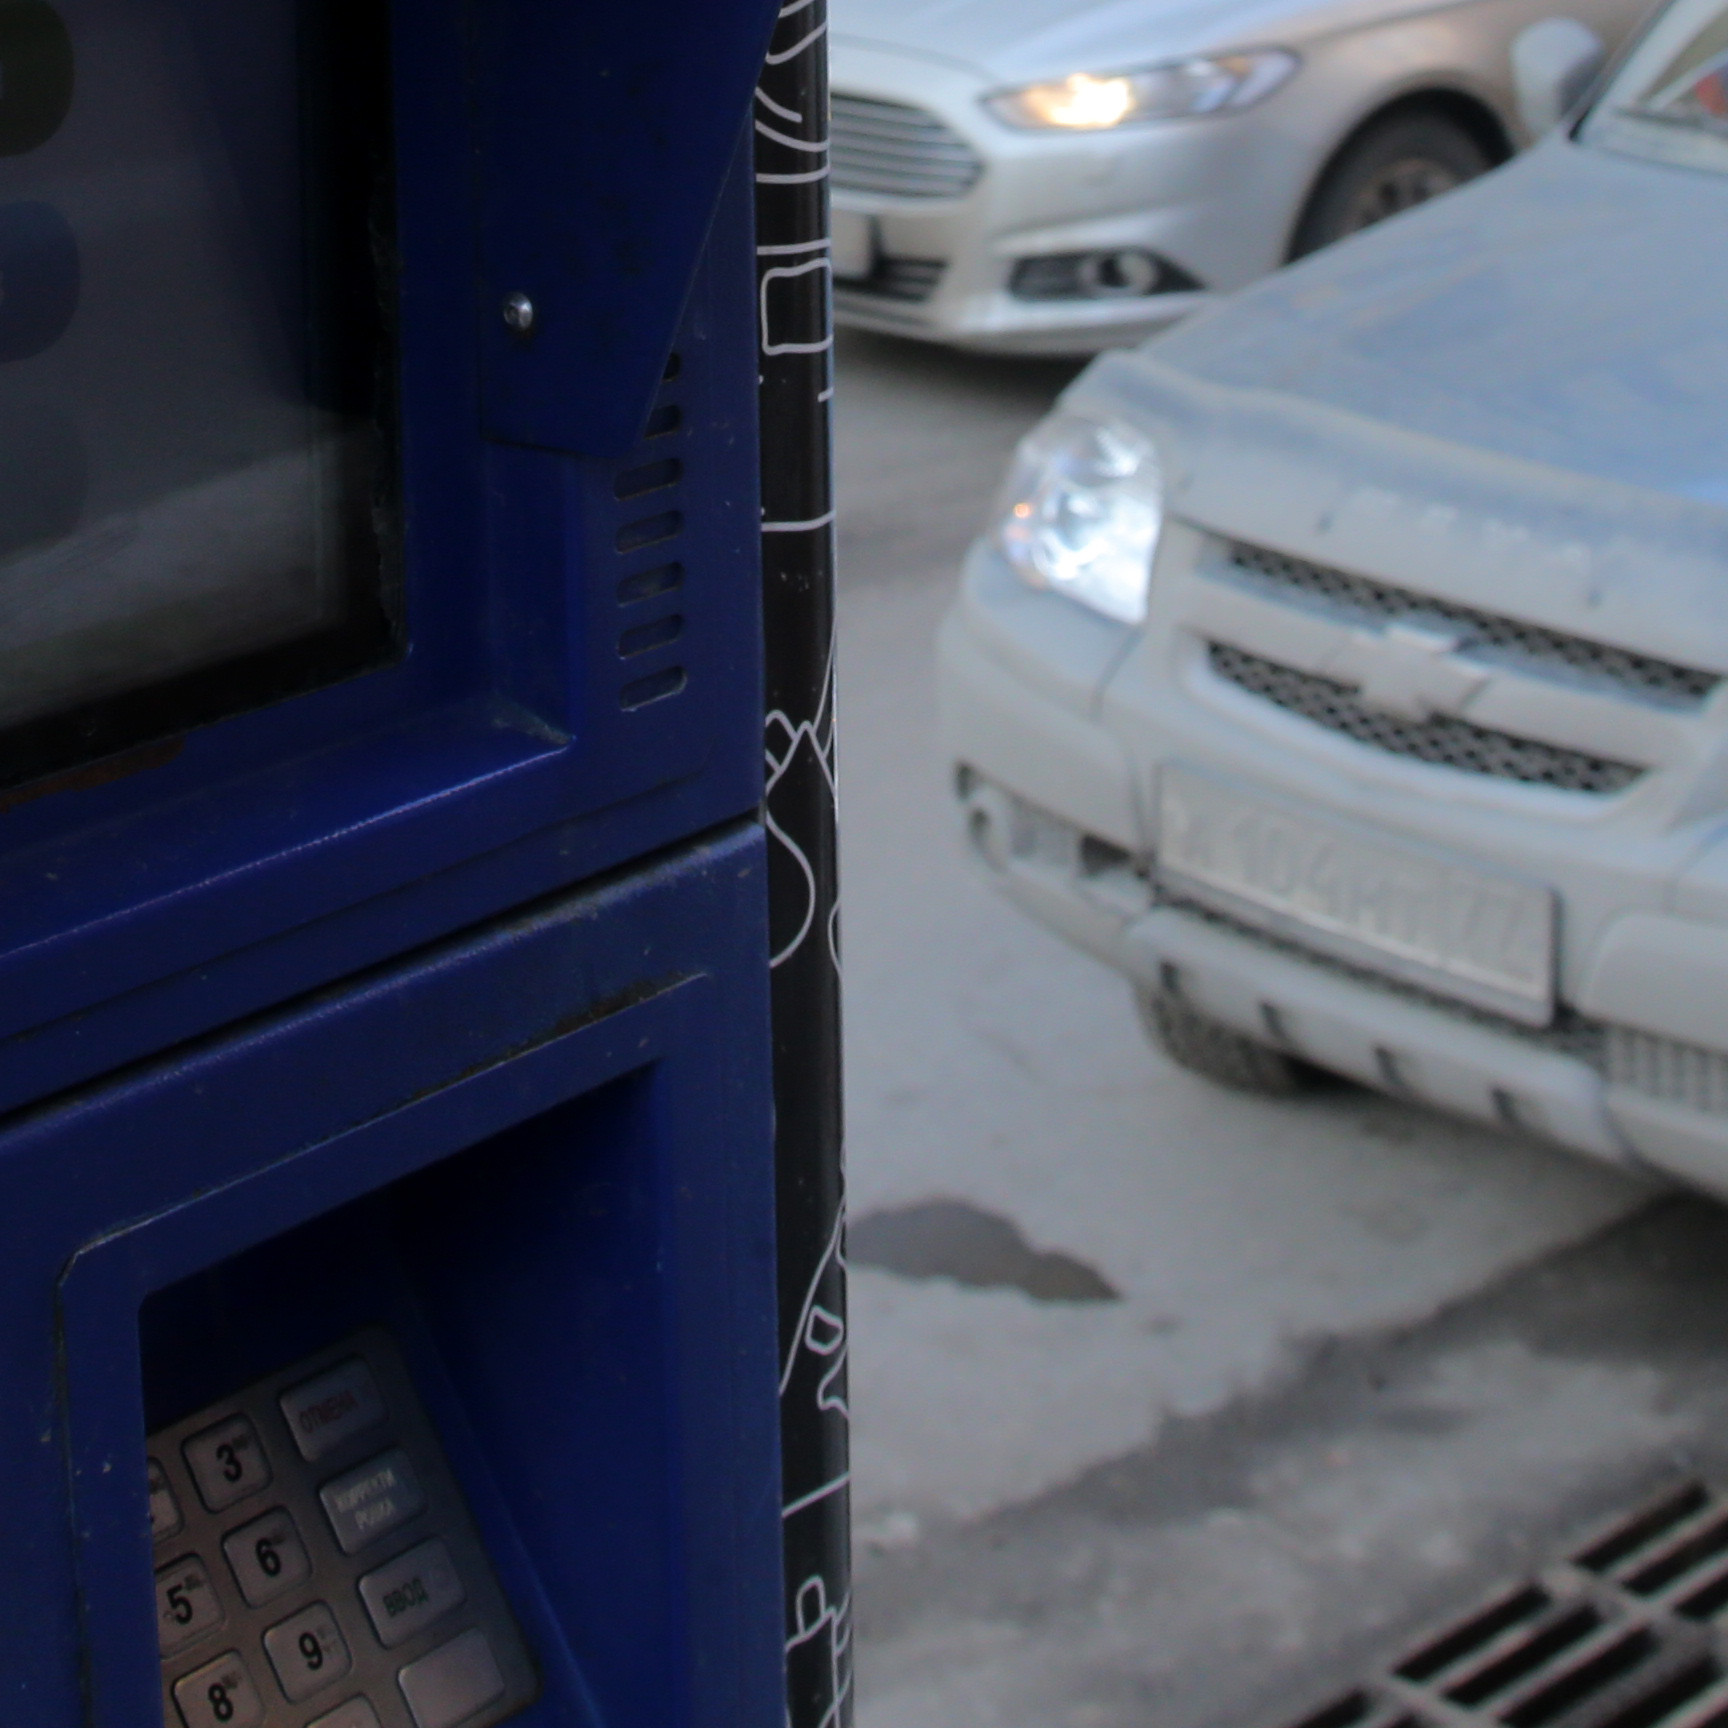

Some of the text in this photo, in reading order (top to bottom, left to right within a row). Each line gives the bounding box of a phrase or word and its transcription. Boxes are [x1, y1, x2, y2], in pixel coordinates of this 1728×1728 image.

[215, 1443, 242, 1482] 3
[255, 1537, 282, 1578] 6
[166, 1584, 193, 1624] 5
[299, 1632, 323, 1670] 9
[208, 1682, 234, 1722] 8
